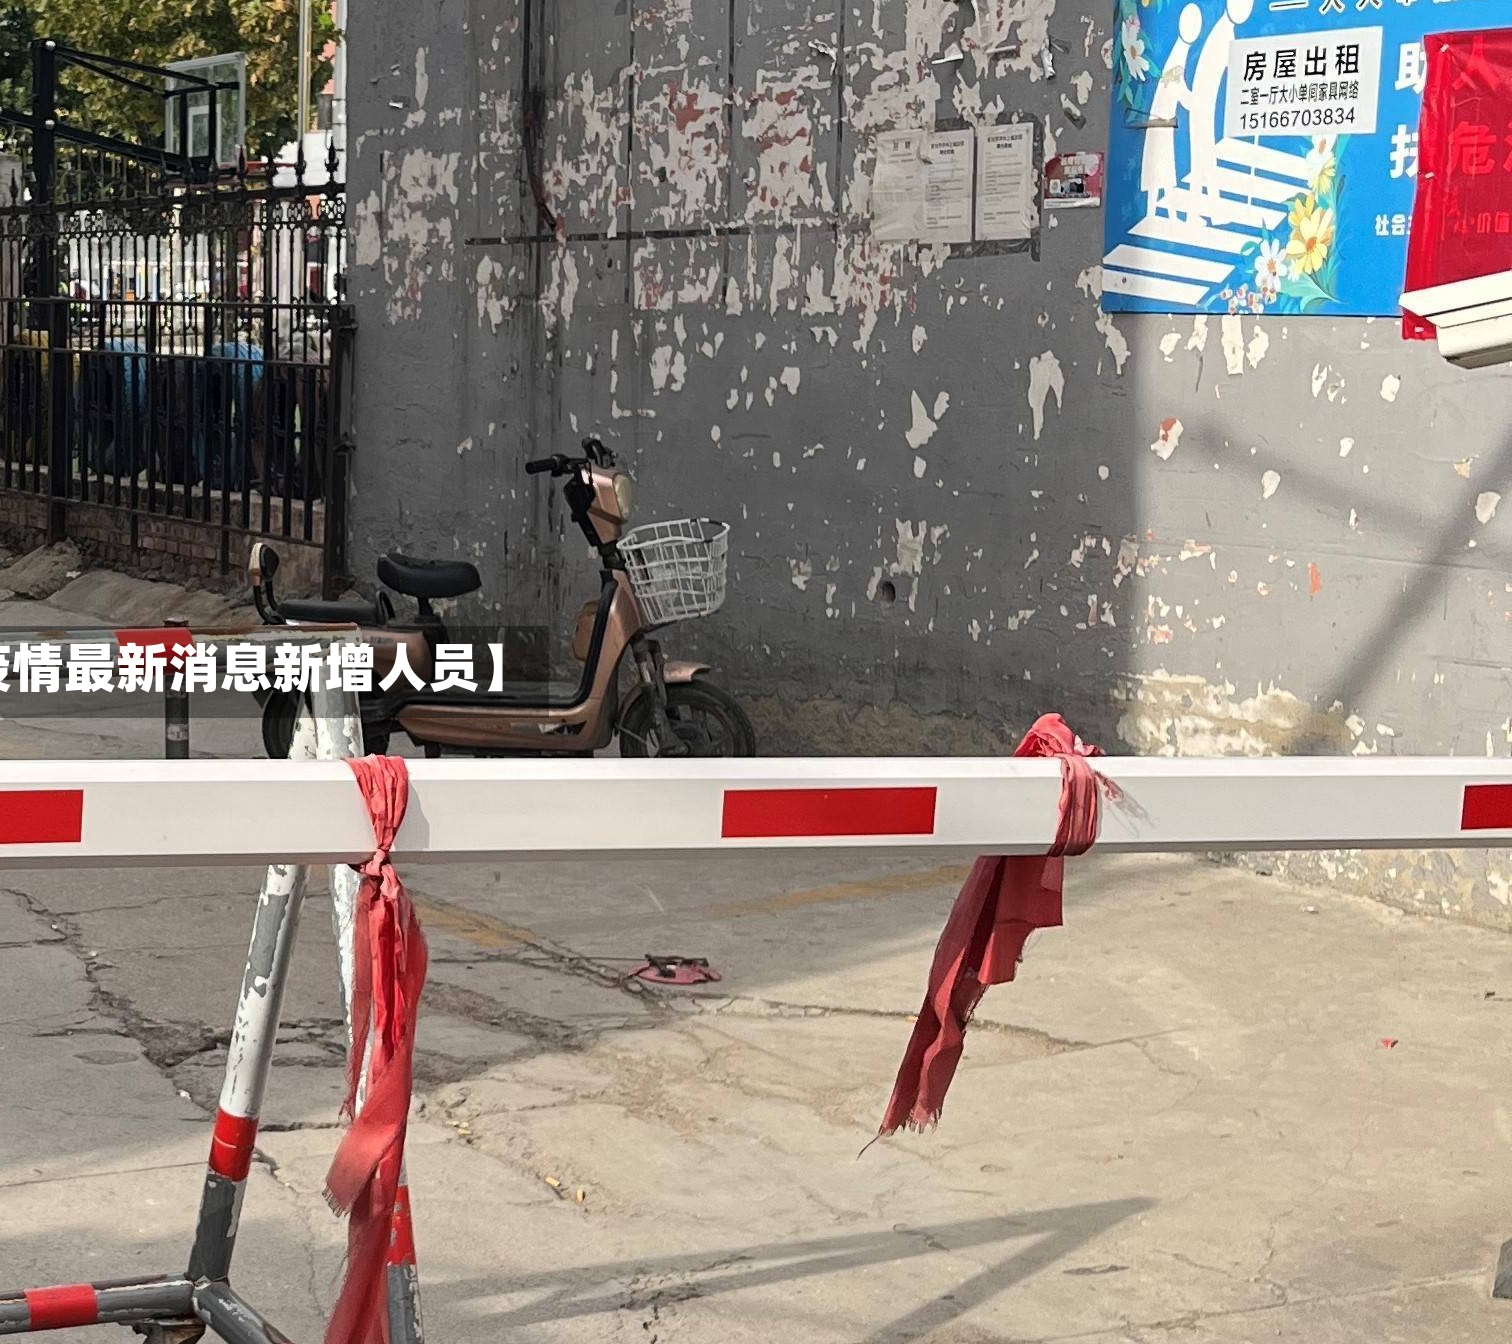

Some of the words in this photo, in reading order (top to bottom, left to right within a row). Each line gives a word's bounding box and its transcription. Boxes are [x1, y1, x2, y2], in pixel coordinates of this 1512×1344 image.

[1243, 44, 1359, 82] 房屋出租
[1240, 107, 1355, 131] 15166703834
